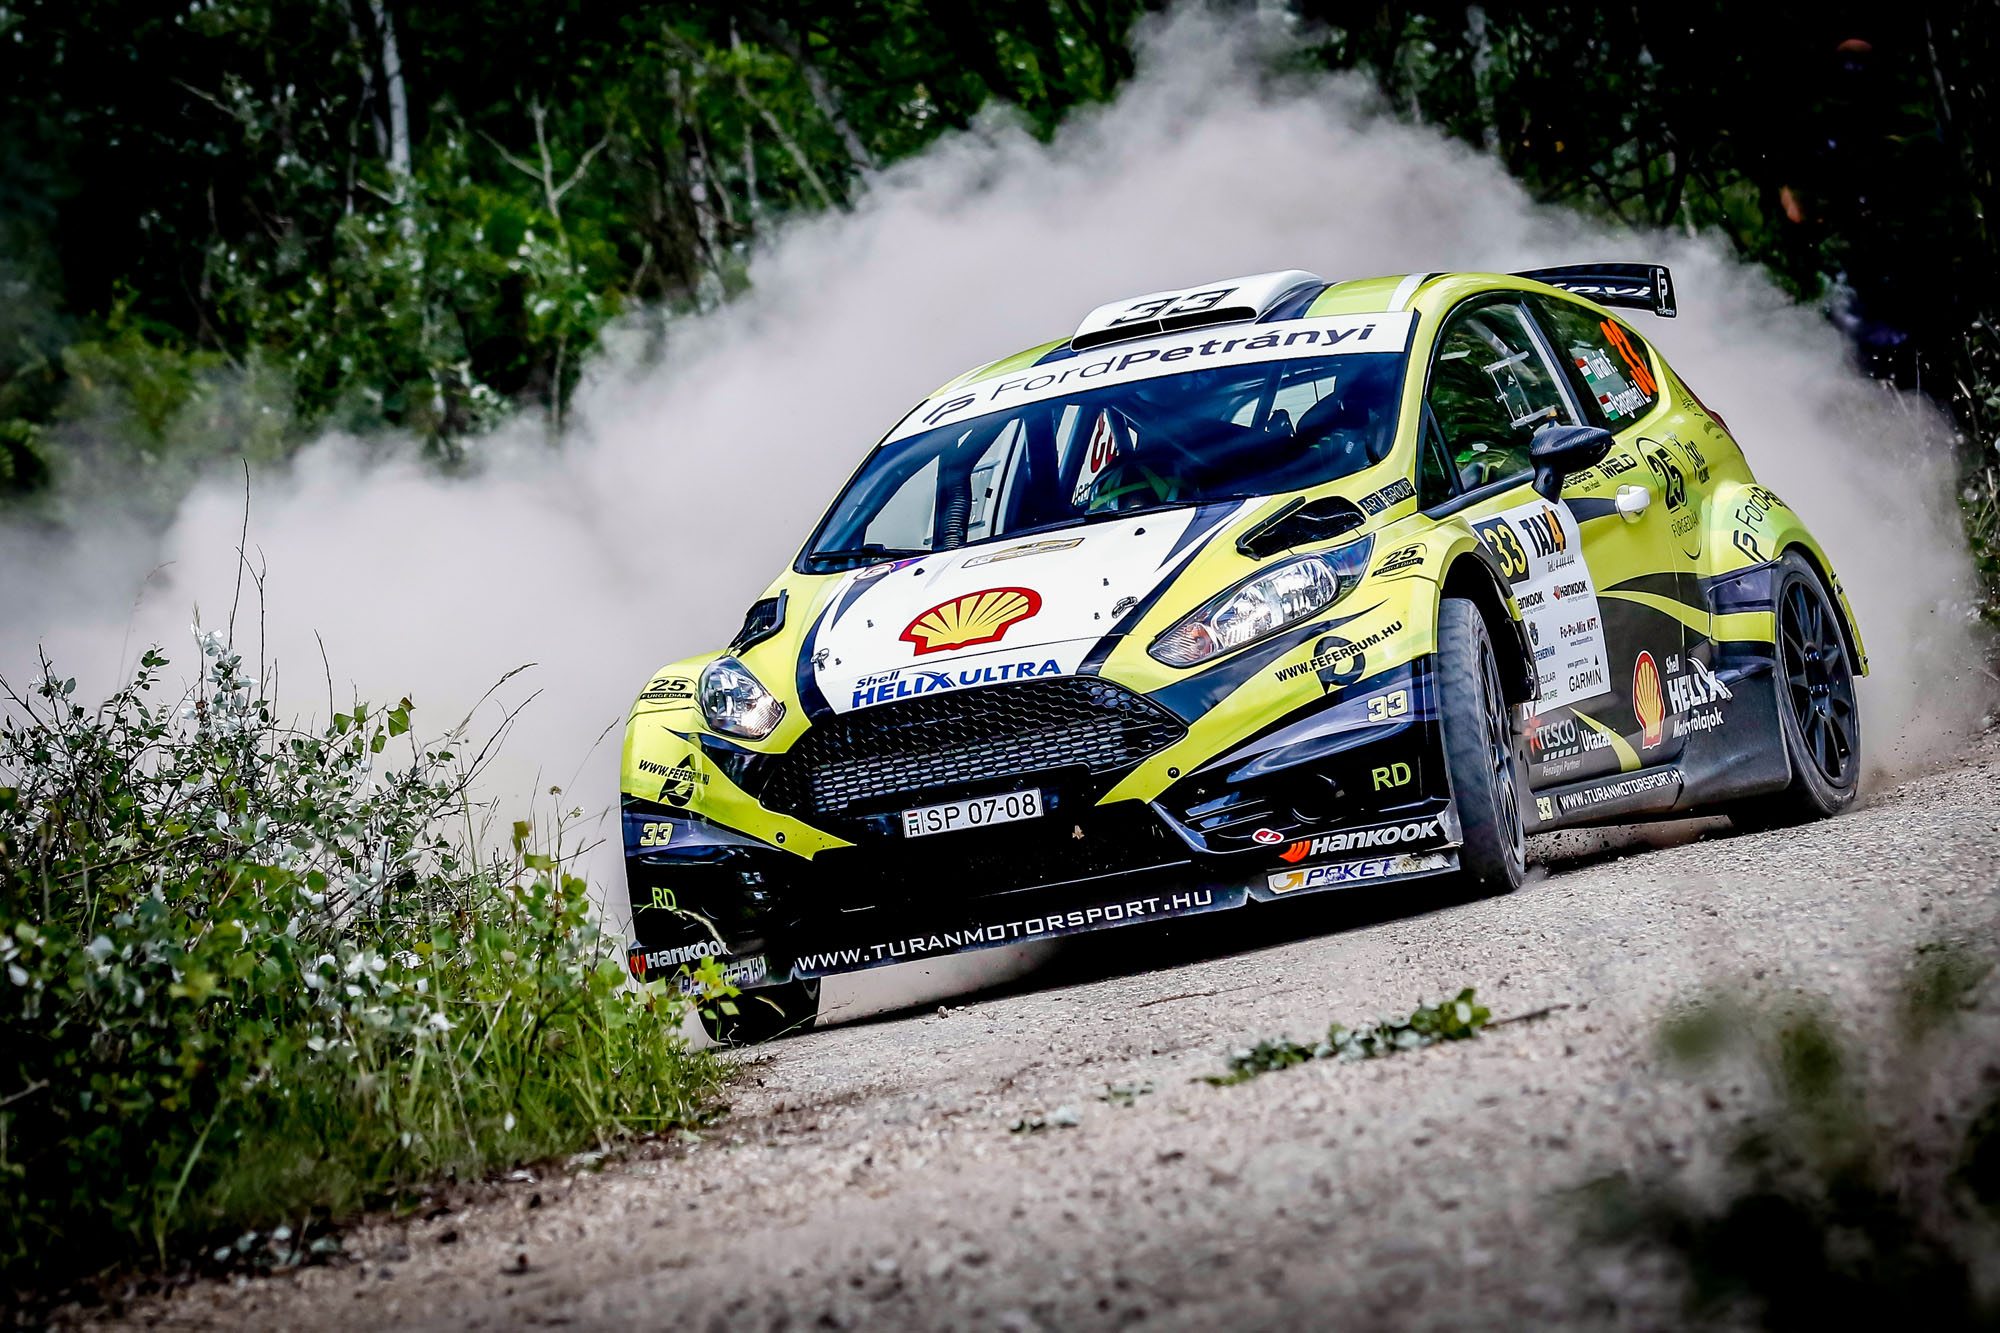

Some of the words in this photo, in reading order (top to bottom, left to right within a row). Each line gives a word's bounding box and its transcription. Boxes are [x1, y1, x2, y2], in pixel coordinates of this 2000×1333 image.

[1384, 545, 1419, 567] 25
[1483, 524, 1527, 578] 33
[1274, 620, 1404, 682] WWW.FEFERRUM.HU
[1665, 653, 1680, 675] Shell
[650, 679, 688, 692] 25
[852, 671, 900, 689] Shell
[852, 672, 956, 709] HELIX
[959, 659, 1062, 685] ULTRA
[1666, 657, 1734, 715] HELIX
[1367, 689, 1408, 723] 33
[1536, 718, 1576, 750] TESCO
[1580, 726, 1612, 752] Utazás
[1372, 762, 1412, 791] RD
[927, 806, 960, 832] SP
[968, 793, 1036, 825] 07-08
[1536, 796, 1554, 821] 33
[639, 822, 674, 847] 33
[651, 887, 677, 910] RD
[797, 888, 1213, 972] WWW.TURANMOTORSPORT.HU
